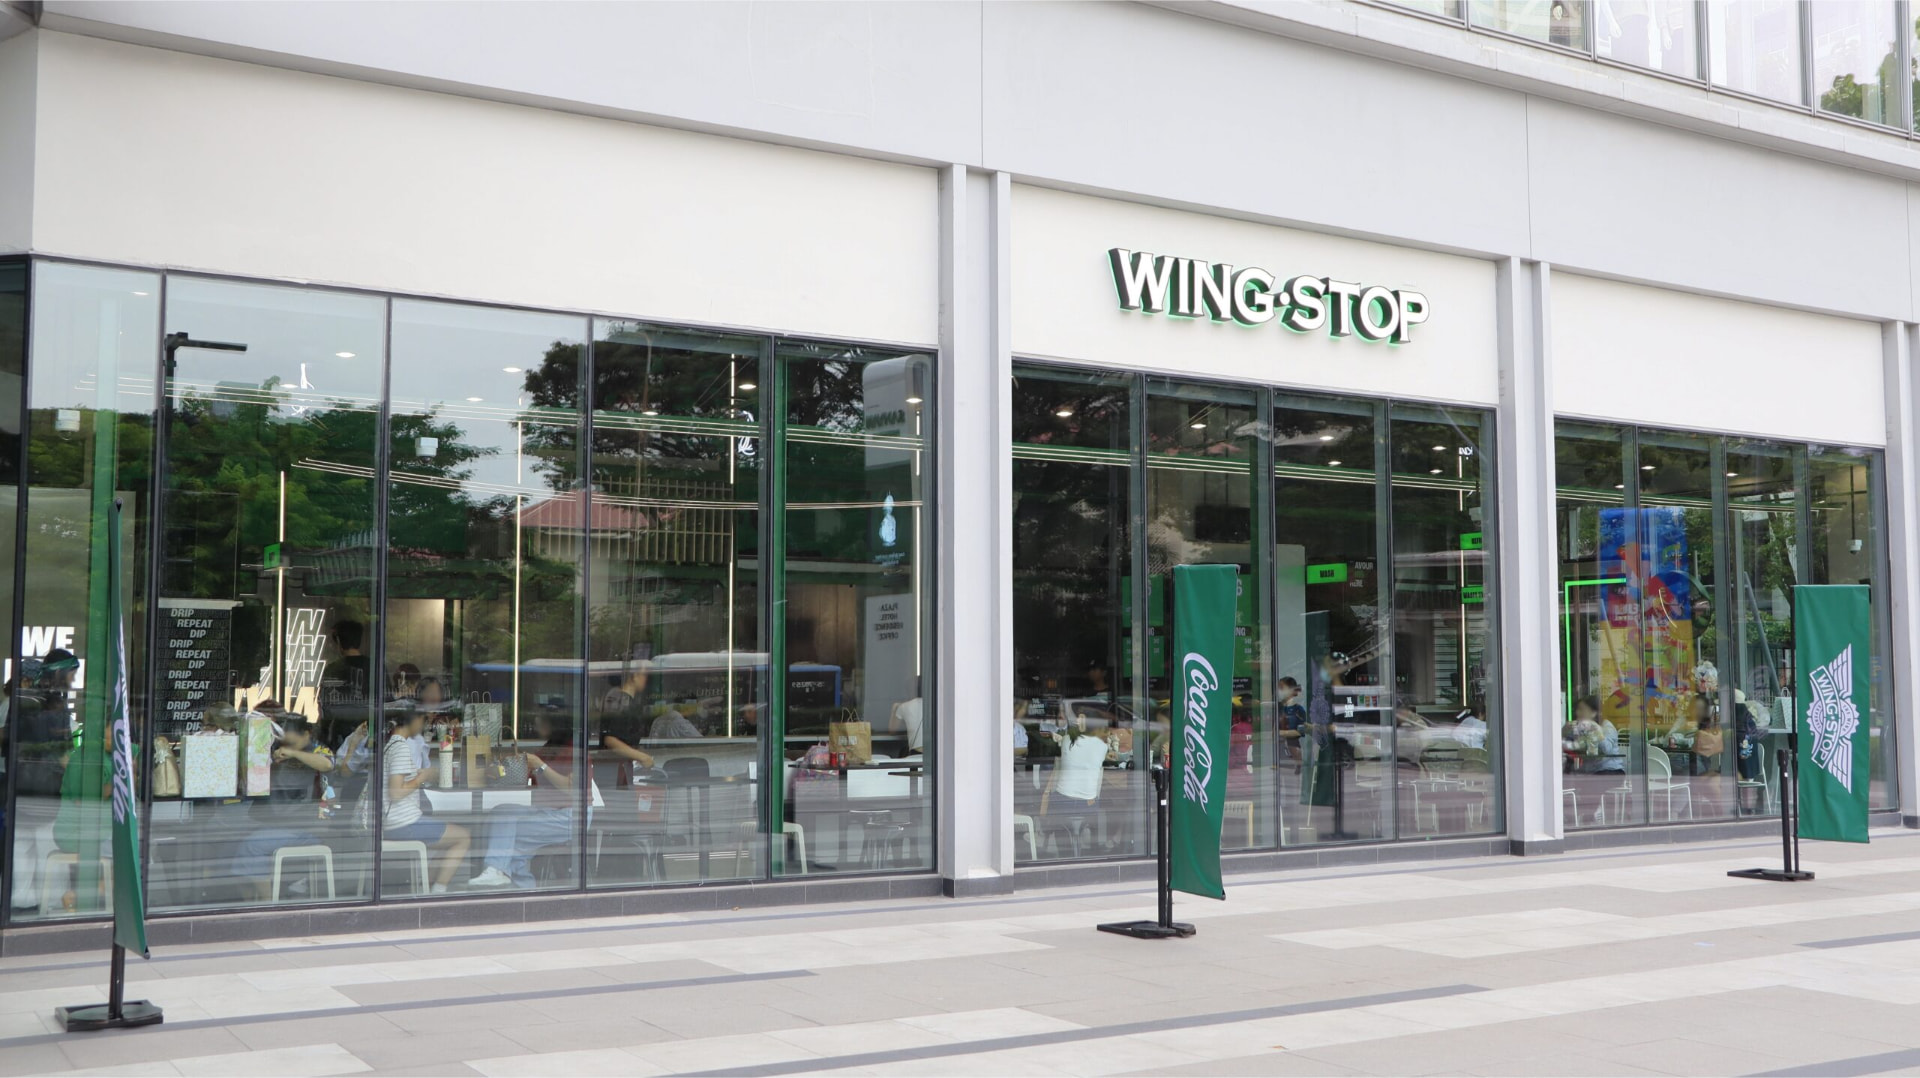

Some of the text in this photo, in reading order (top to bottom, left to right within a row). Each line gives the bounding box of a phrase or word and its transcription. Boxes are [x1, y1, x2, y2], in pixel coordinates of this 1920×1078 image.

[171, 608, 195, 617] DRIP
[177, 619, 213, 628] REPEAT
[189, 629, 207, 638] DIP
[21, 626, 76, 657] WE
[169, 639, 193, 648] DRIP
[175, 650, 212, 659] REPEAT
[188, 660, 205, 669] DIP
[168, 670, 192, 679] DRIP
[174, 681, 211, 690] REPEAT
[187, 691, 204, 700] DIP
[166, 701, 191, 710] DRIP
[173, 711, 204, 721] REPEA
